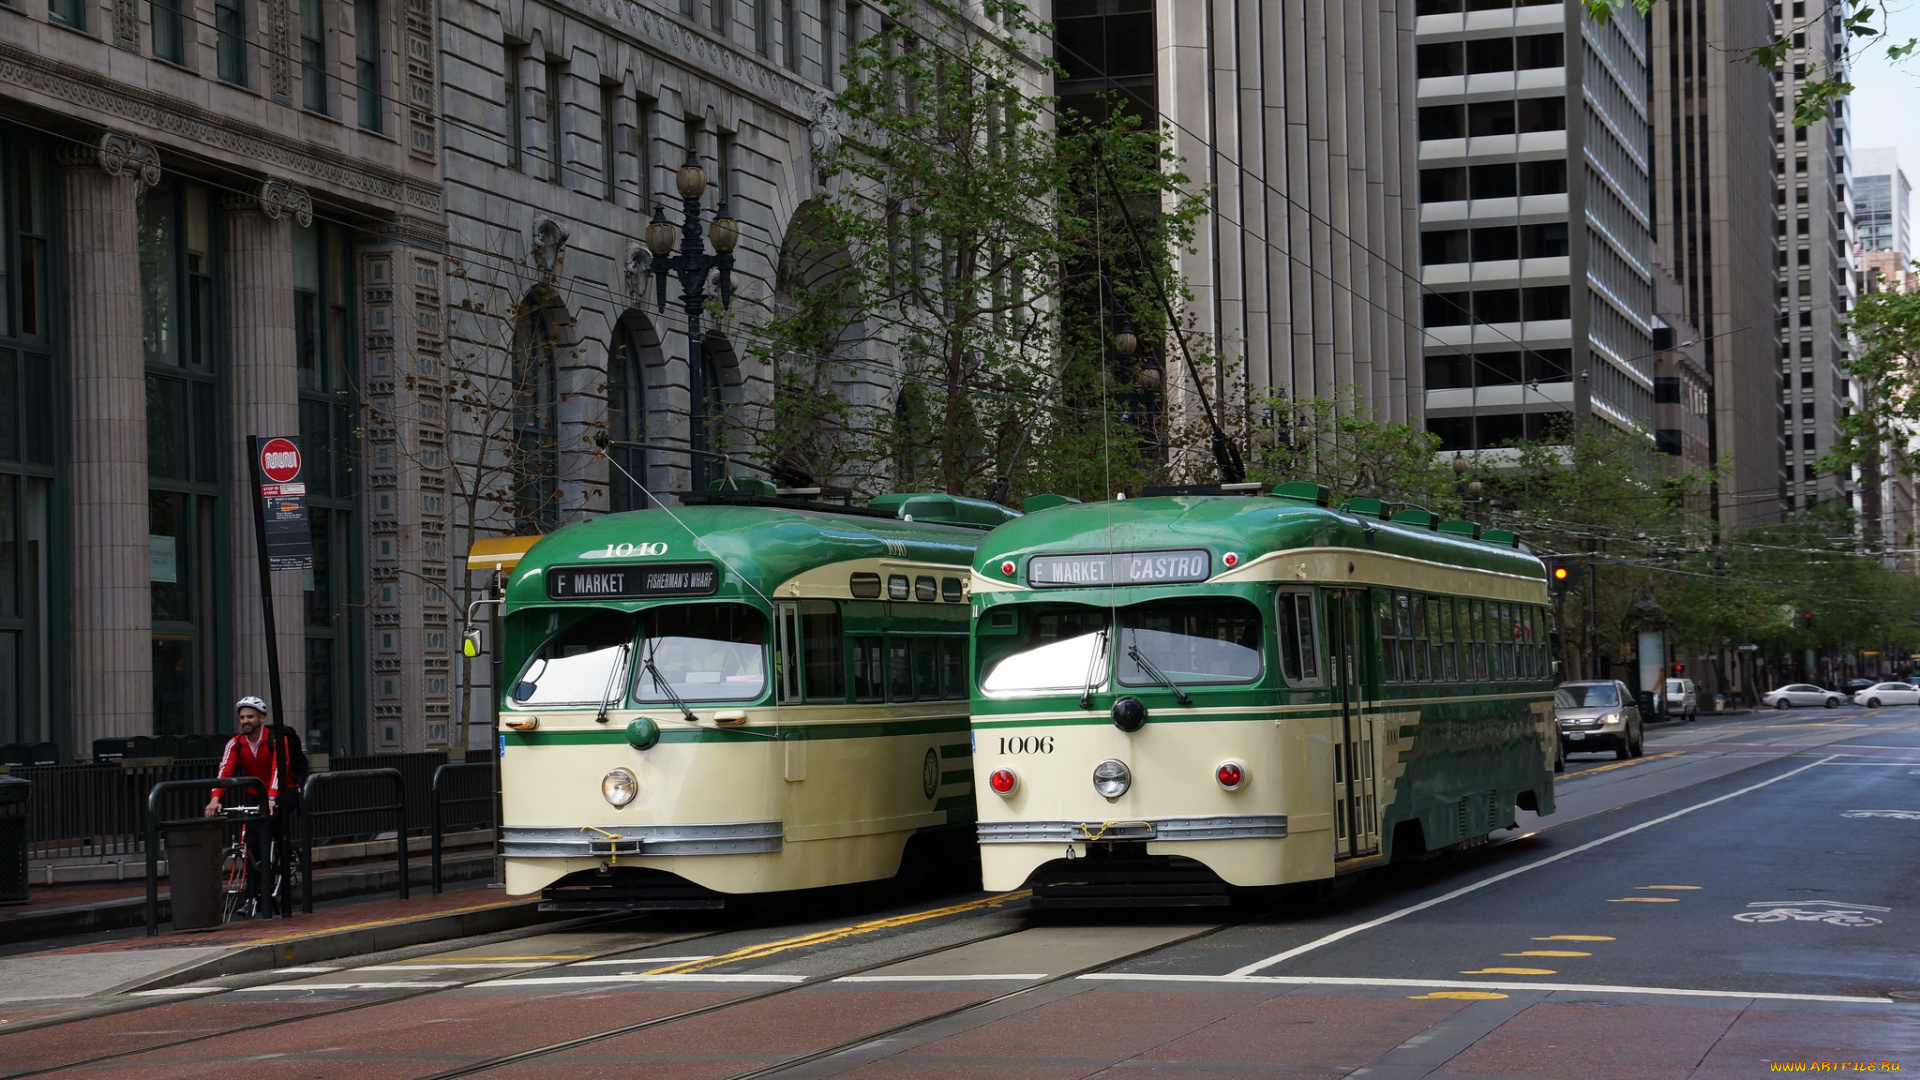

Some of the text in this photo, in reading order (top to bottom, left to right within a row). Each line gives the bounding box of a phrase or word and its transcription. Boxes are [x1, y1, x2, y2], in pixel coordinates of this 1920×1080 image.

[267, 498, 273, 509] F
[603, 542, 669, 558] 1040
[1034, 555, 1203, 583] F MARKET CASTRO
[558, 572, 713, 594] F MARKET FISHERMAN'S WHARF
[997, 735, 1055, 755] 1006
